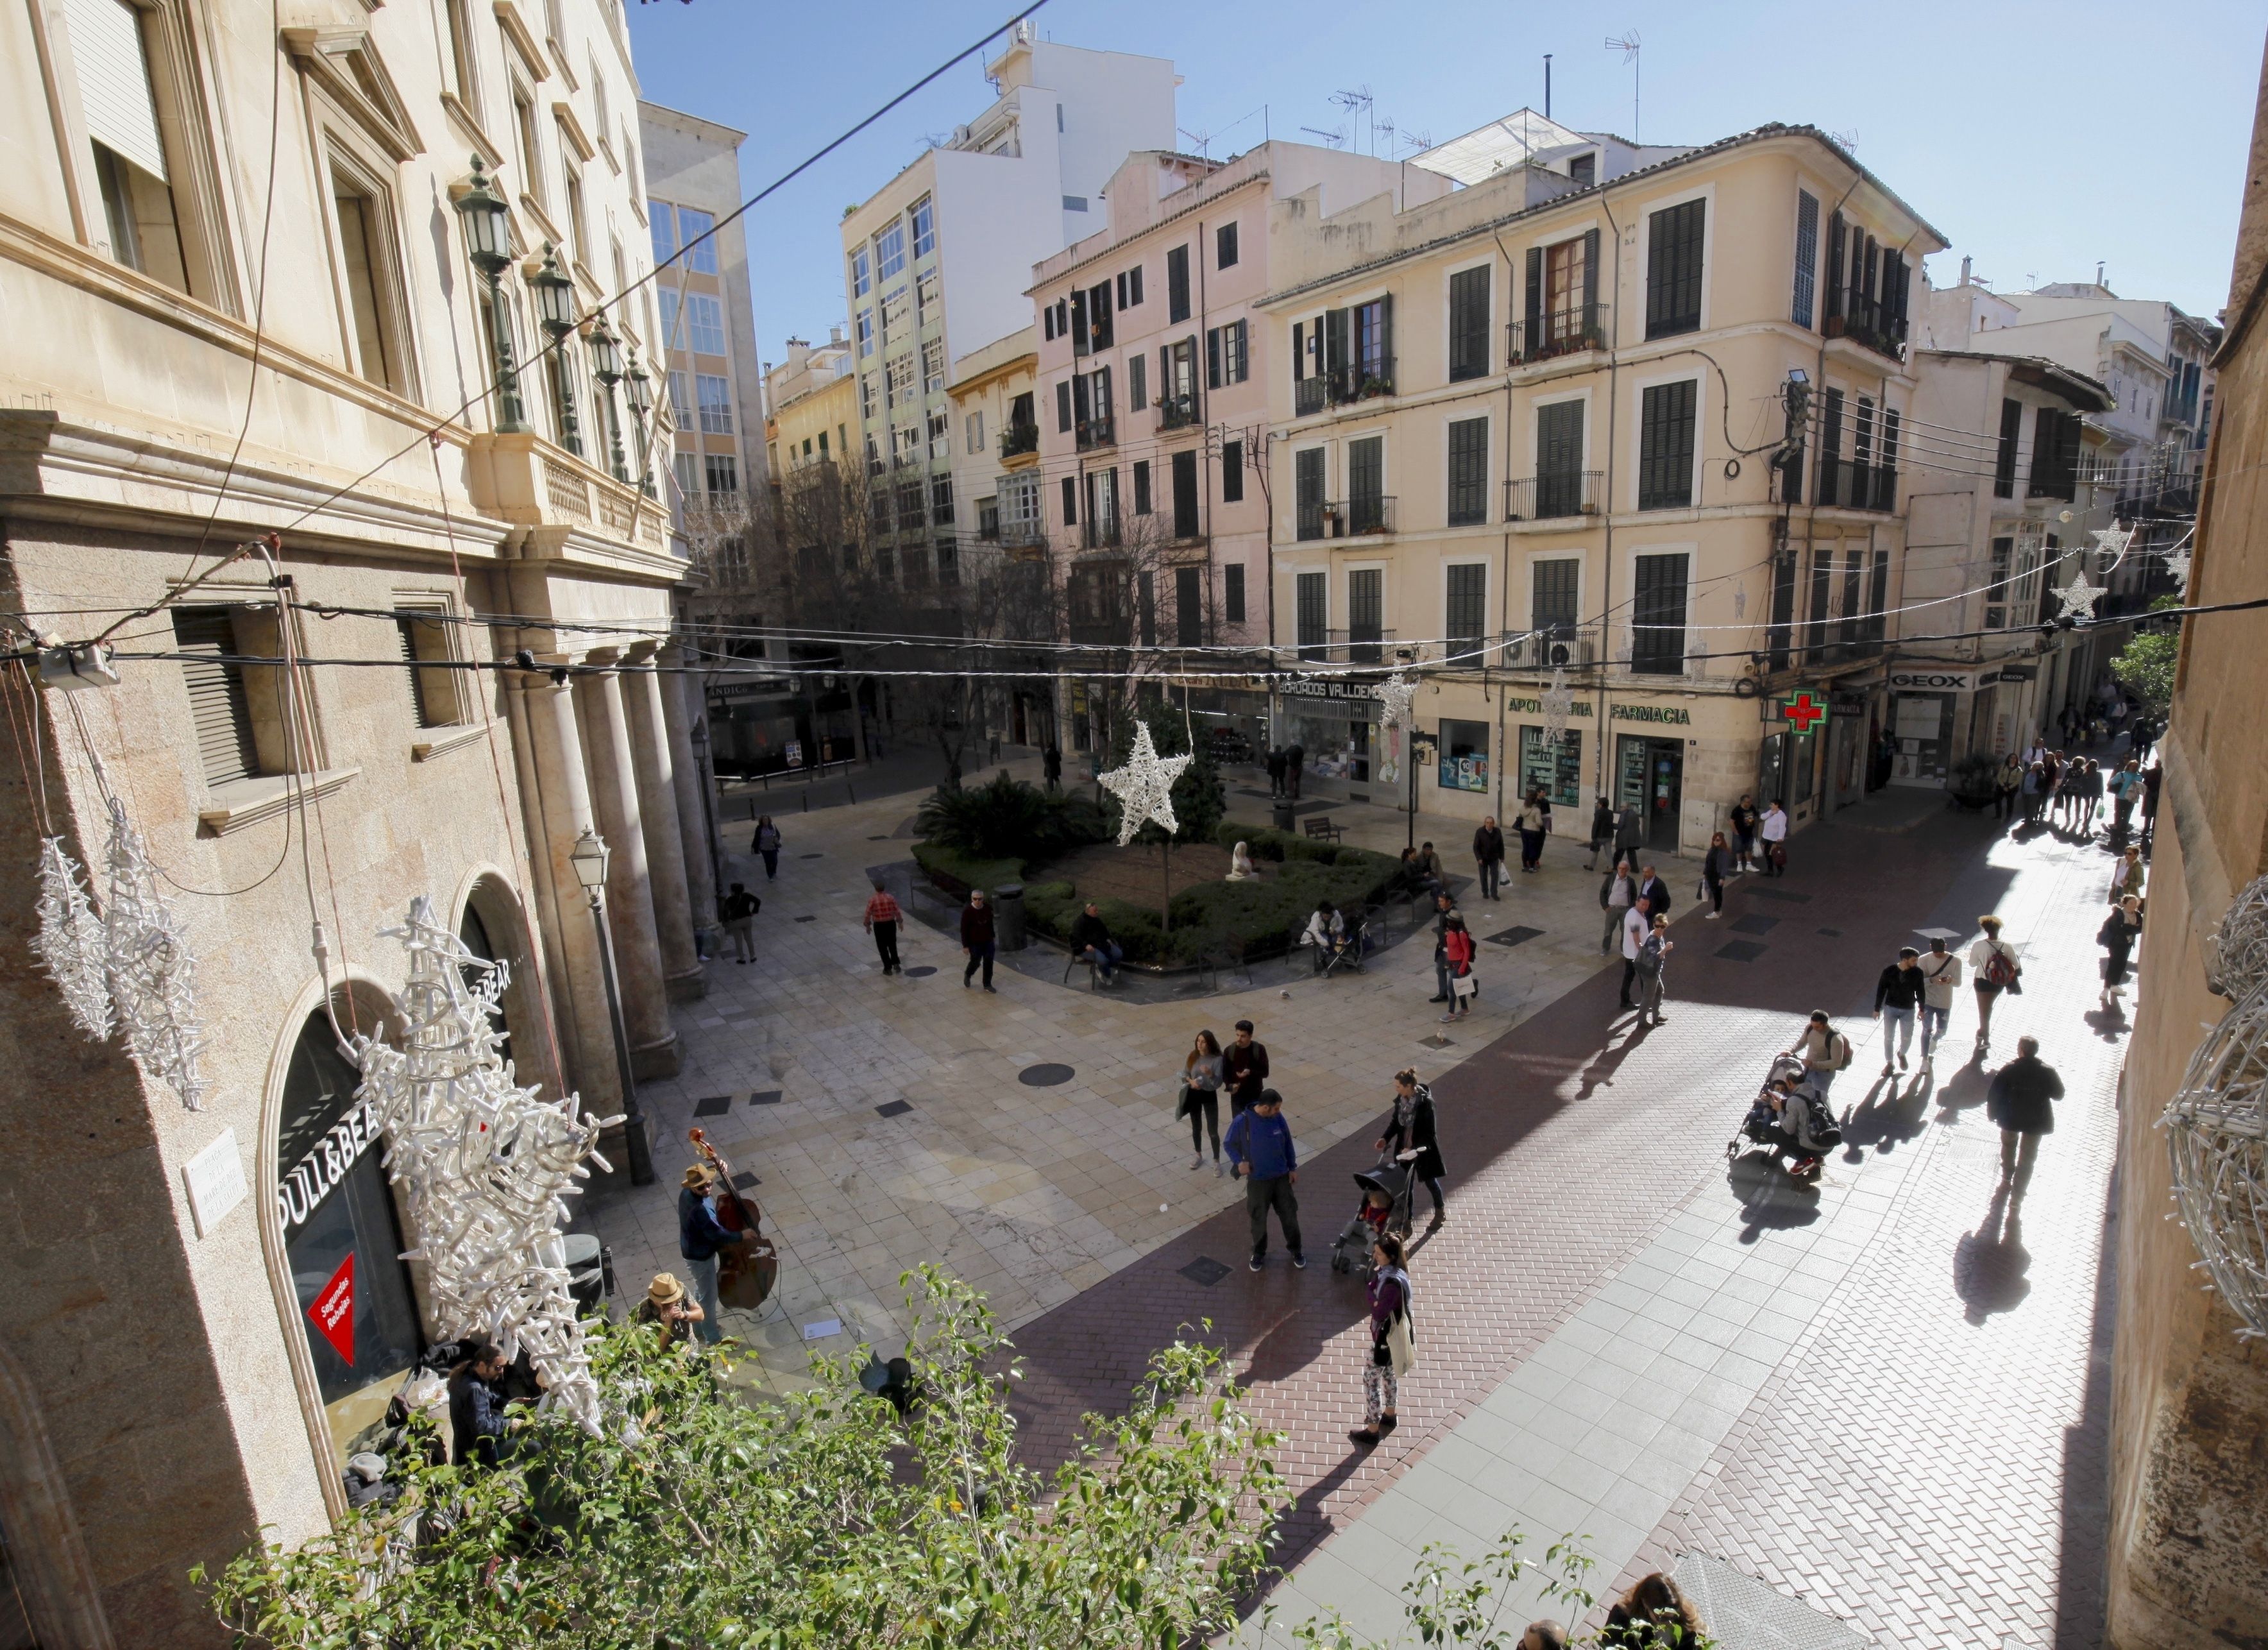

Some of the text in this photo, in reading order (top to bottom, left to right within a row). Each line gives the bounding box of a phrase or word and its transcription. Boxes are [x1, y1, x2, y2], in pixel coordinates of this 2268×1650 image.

[1279, 683, 1382, 700] BORDADOS VALLDEMO
[1893, 674, 1967, 688] GEOX
[1508, 698, 1593, 717] APOTRIA
[1611, 704, 1690, 725] FARMACIA
[217, 1163, 224, 1176] LA
[278, 1103, 380, 1232] PULL&BEA
[207, 1205, 216, 1219] DE
[216, 1198, 223, 1212] LA
[321, 1277, 350, 1318] Segundas
[327, 1295, 351, 1331] Rebajas
